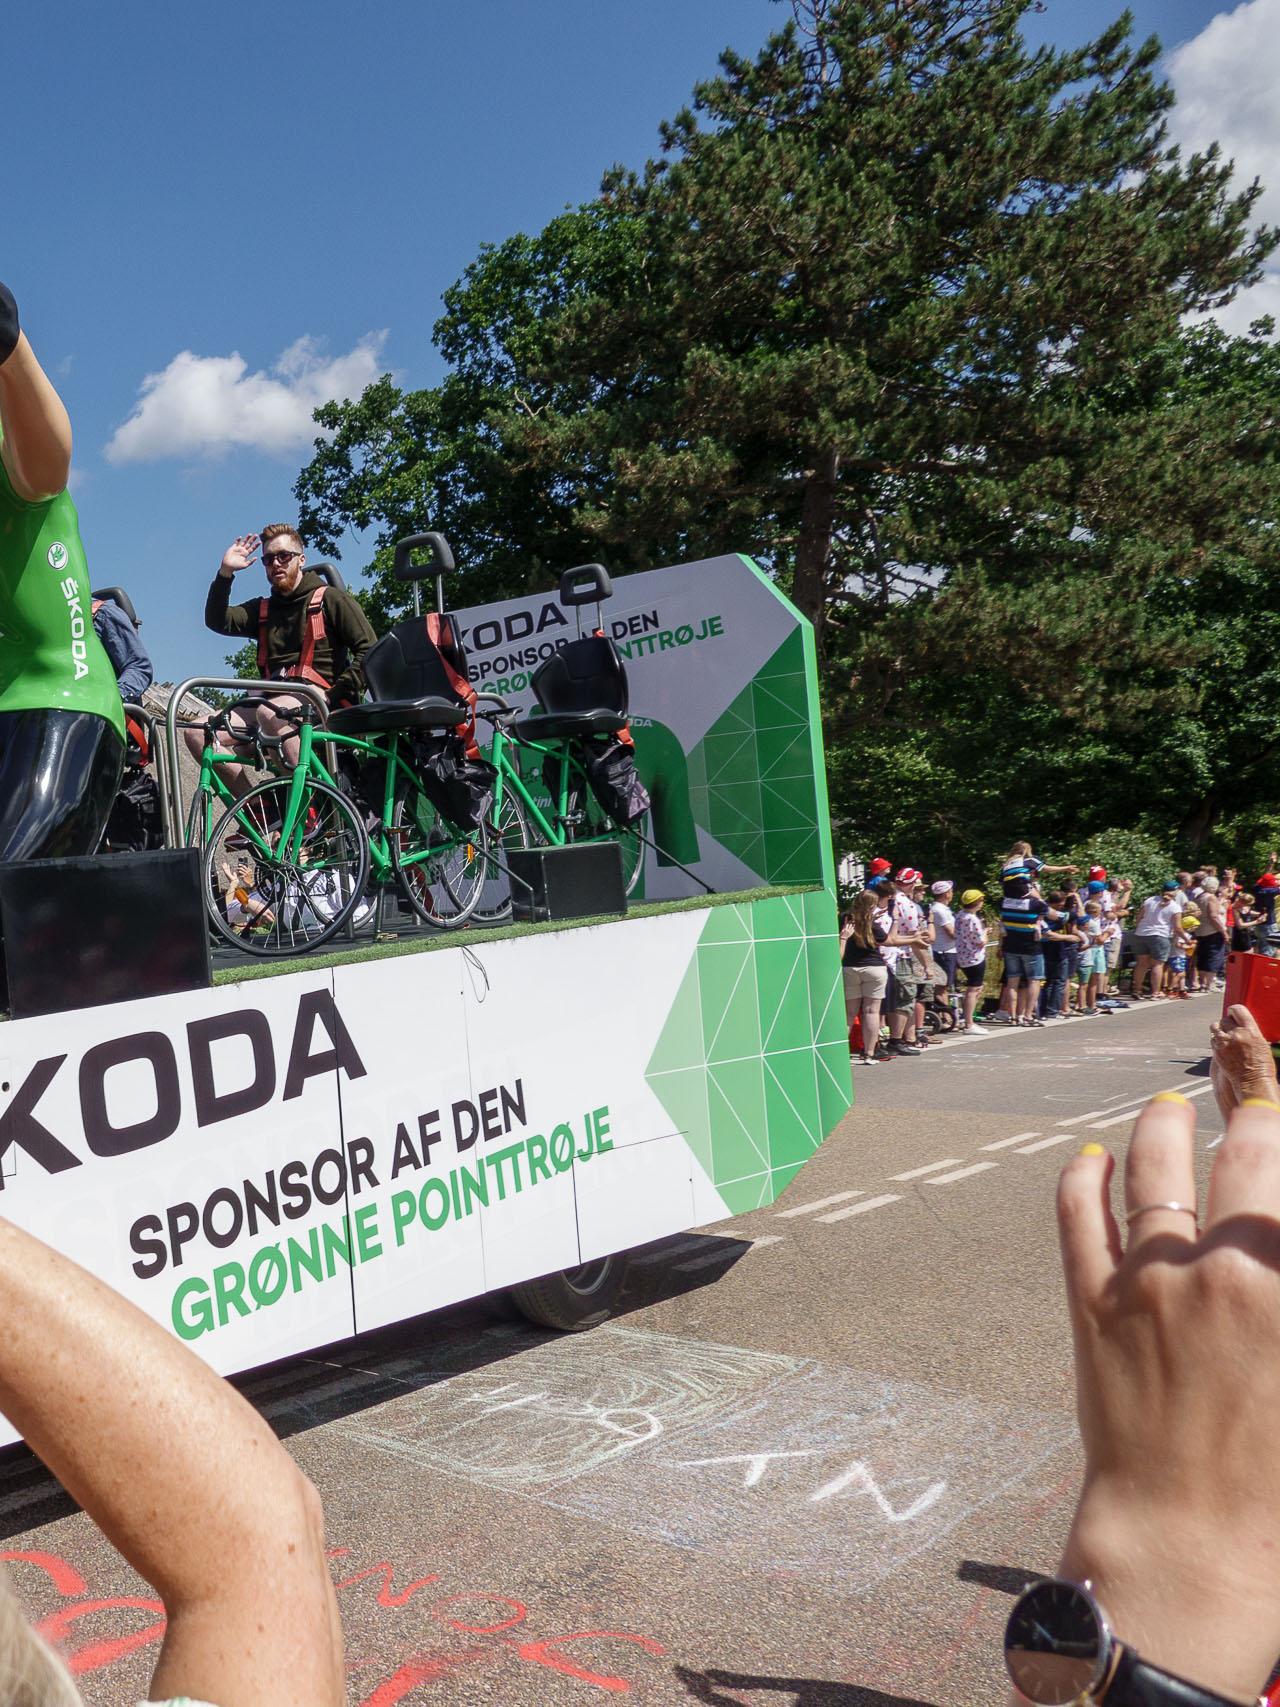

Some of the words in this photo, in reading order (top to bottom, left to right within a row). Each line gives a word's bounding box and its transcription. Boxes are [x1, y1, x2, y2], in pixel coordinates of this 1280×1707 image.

[60, 576, 89, 681] ŠKODA
[461, 602, 569, 655] ODA
[611, 610, 660, 641] DEN
[616, 615, 725, 660] NTTRØJE
[129, 1136, 381, 1280] SPONSOR
[391, 1109, 442, 1180] AF
[451, 1078, 528, 1154] DEN
[171, 1202, 384, 1341] GRØNNE
[391, 1105, 615, 1247] POINTTRØJE
